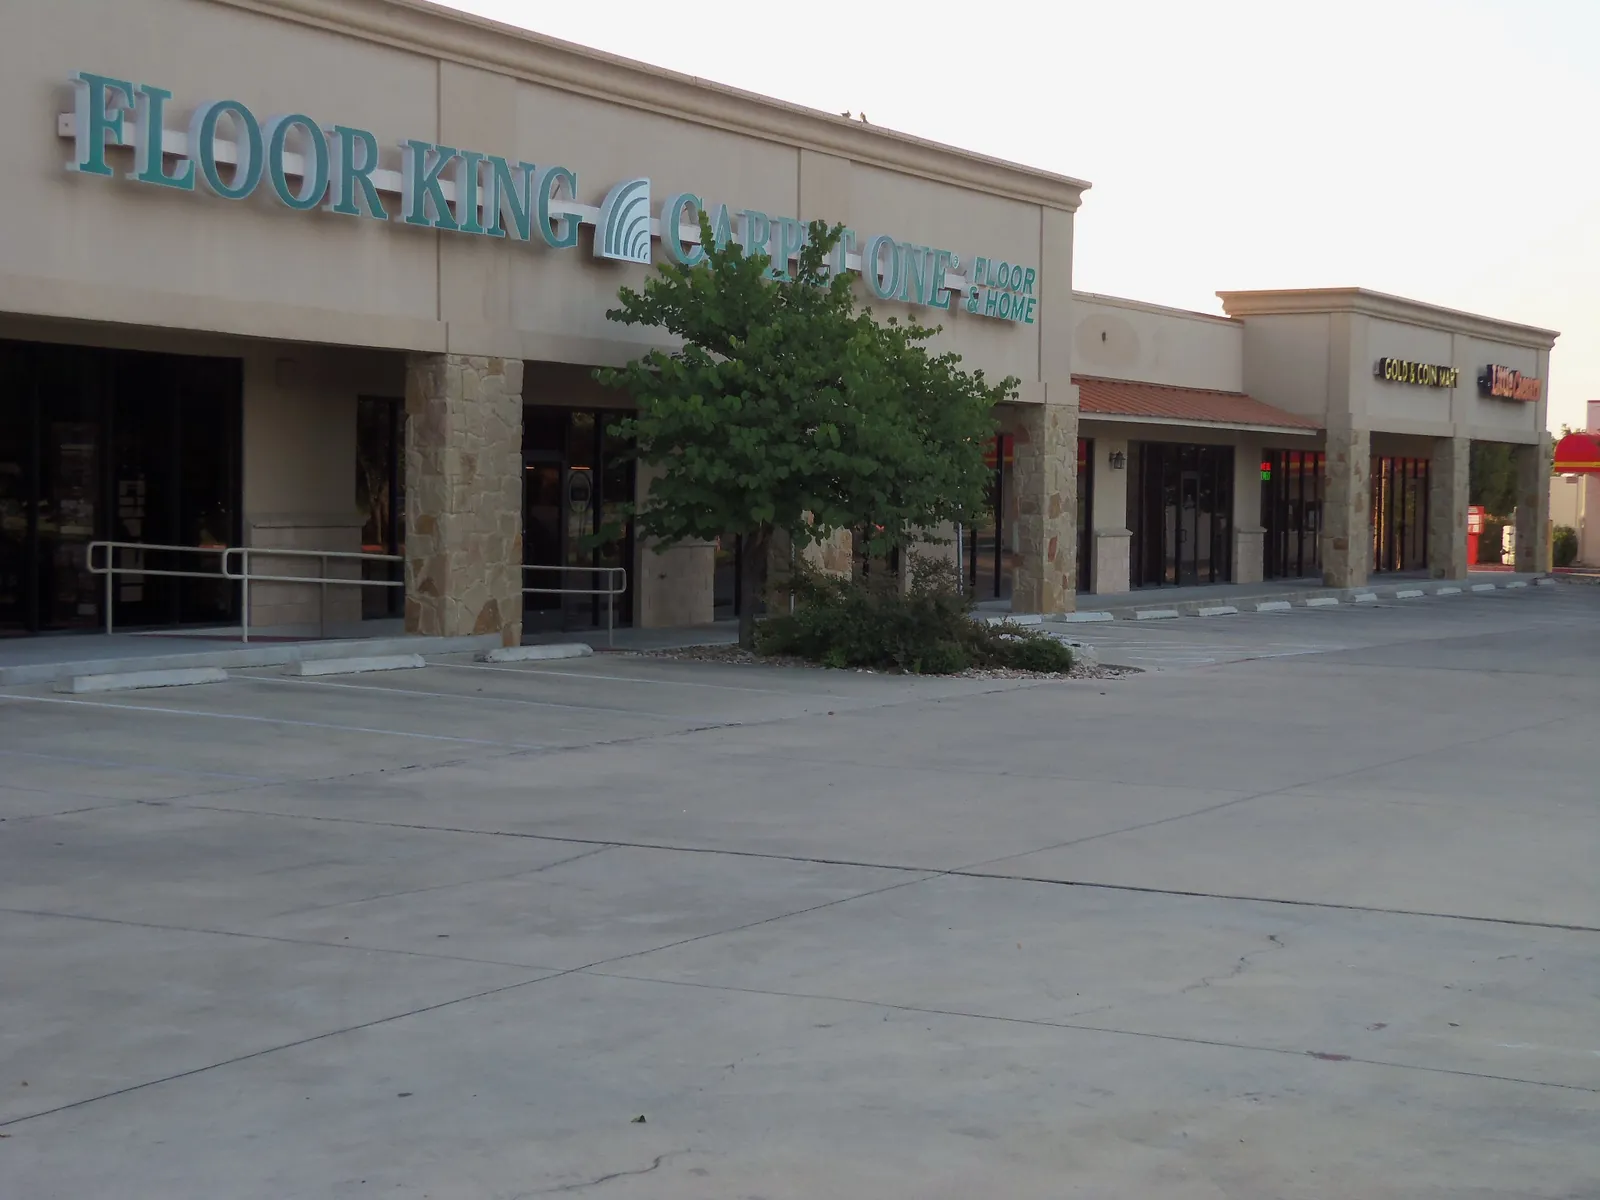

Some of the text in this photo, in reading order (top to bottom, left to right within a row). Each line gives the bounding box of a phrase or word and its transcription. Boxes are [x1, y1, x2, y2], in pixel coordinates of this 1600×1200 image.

[70, 70, 583, 249] FLOOR KING
[973, 255, 1036, 295] FLOOR
[966, 285, 1038, 325] & HOME
[1383, 357, 1408, 382] GOLD
[1417, 362, 1438, 386] COIN
